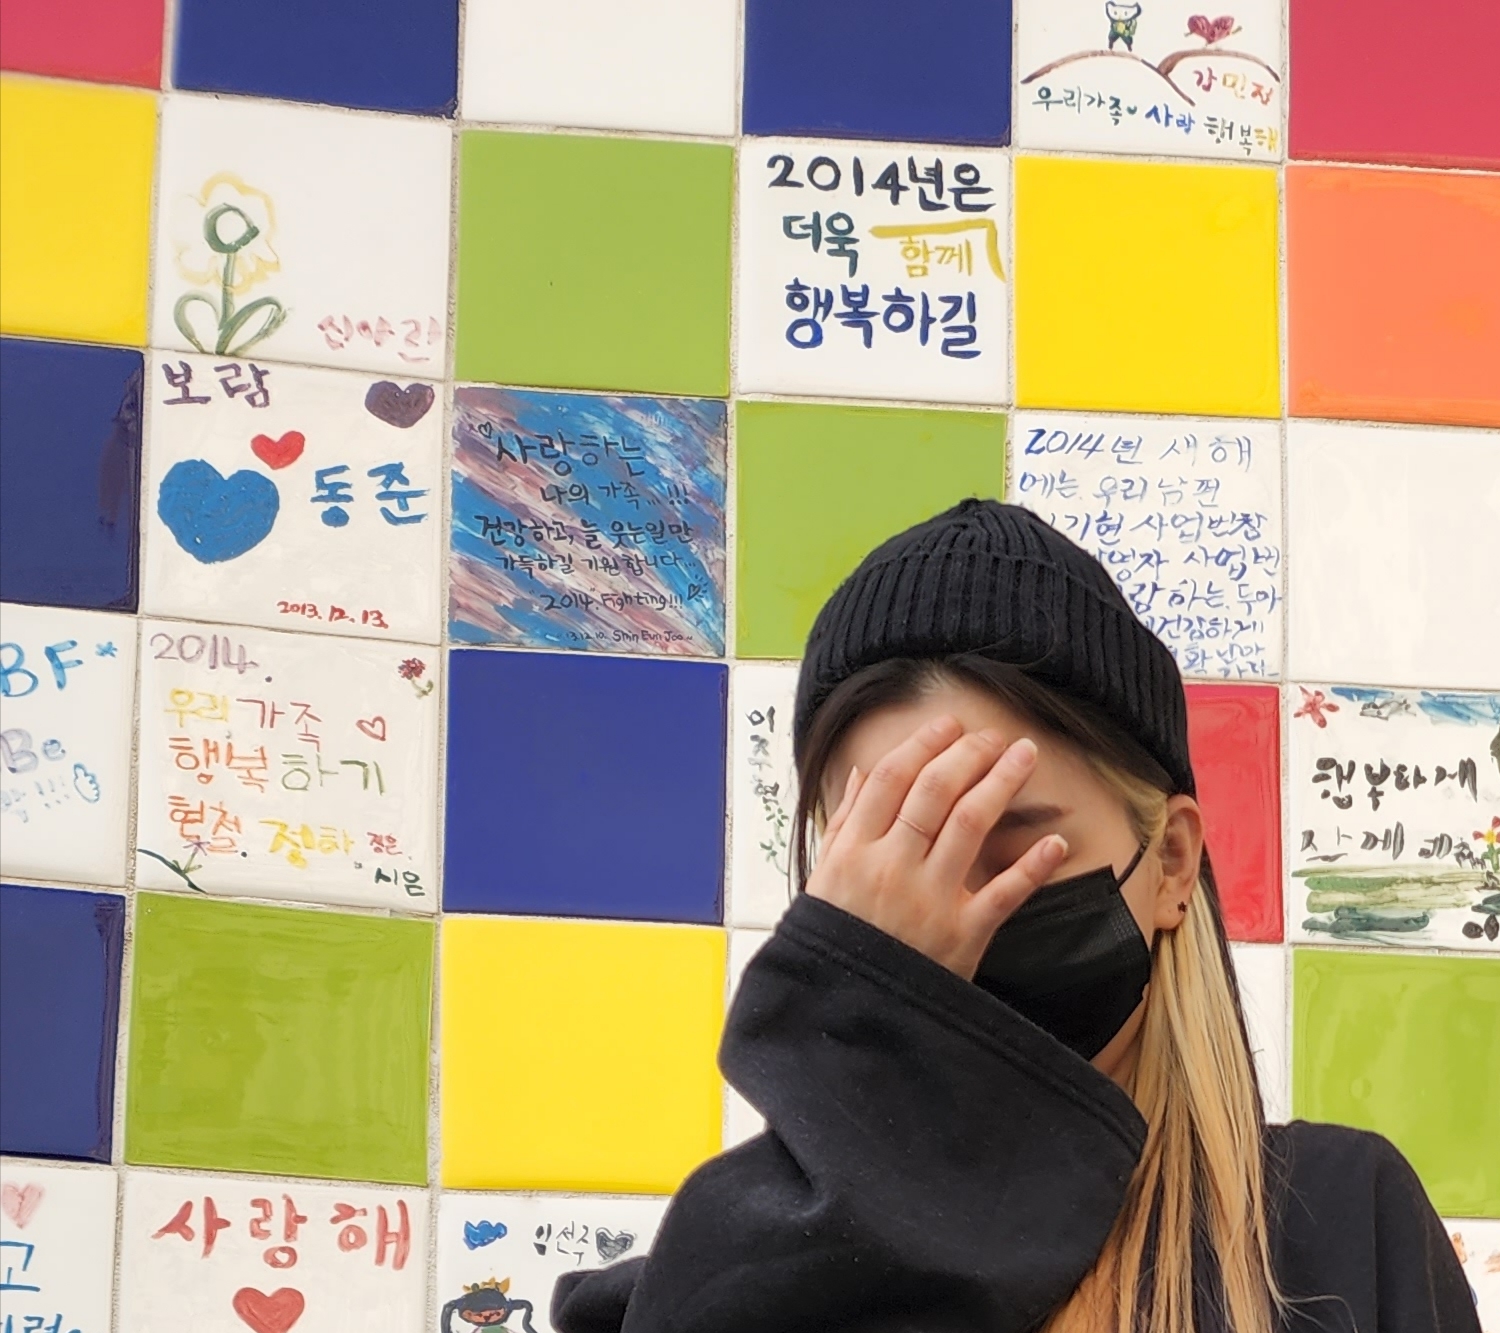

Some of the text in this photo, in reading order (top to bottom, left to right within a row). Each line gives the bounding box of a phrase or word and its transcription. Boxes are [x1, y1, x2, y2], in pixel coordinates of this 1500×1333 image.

[766, 154, 997, 213] 2014년은
[782, 210, 974, 278] 더욱 함께
[784, 276, 983, 361] 행복하길
[162, 361, 270, 408] 보람
[497, 432, 645, 477] 사랑하는
[1024, 428, 1143, 464] 2014년
[310, 462, 430, 527] 동준
[540, 484, 590, 506] 나의
[580, 518, 602, 549] 늘
[496, 553, 575, 578] 가득하길
[168, 737, 385, 794] 행복하기
[151, 1193, 411, 1271] 사랑해
